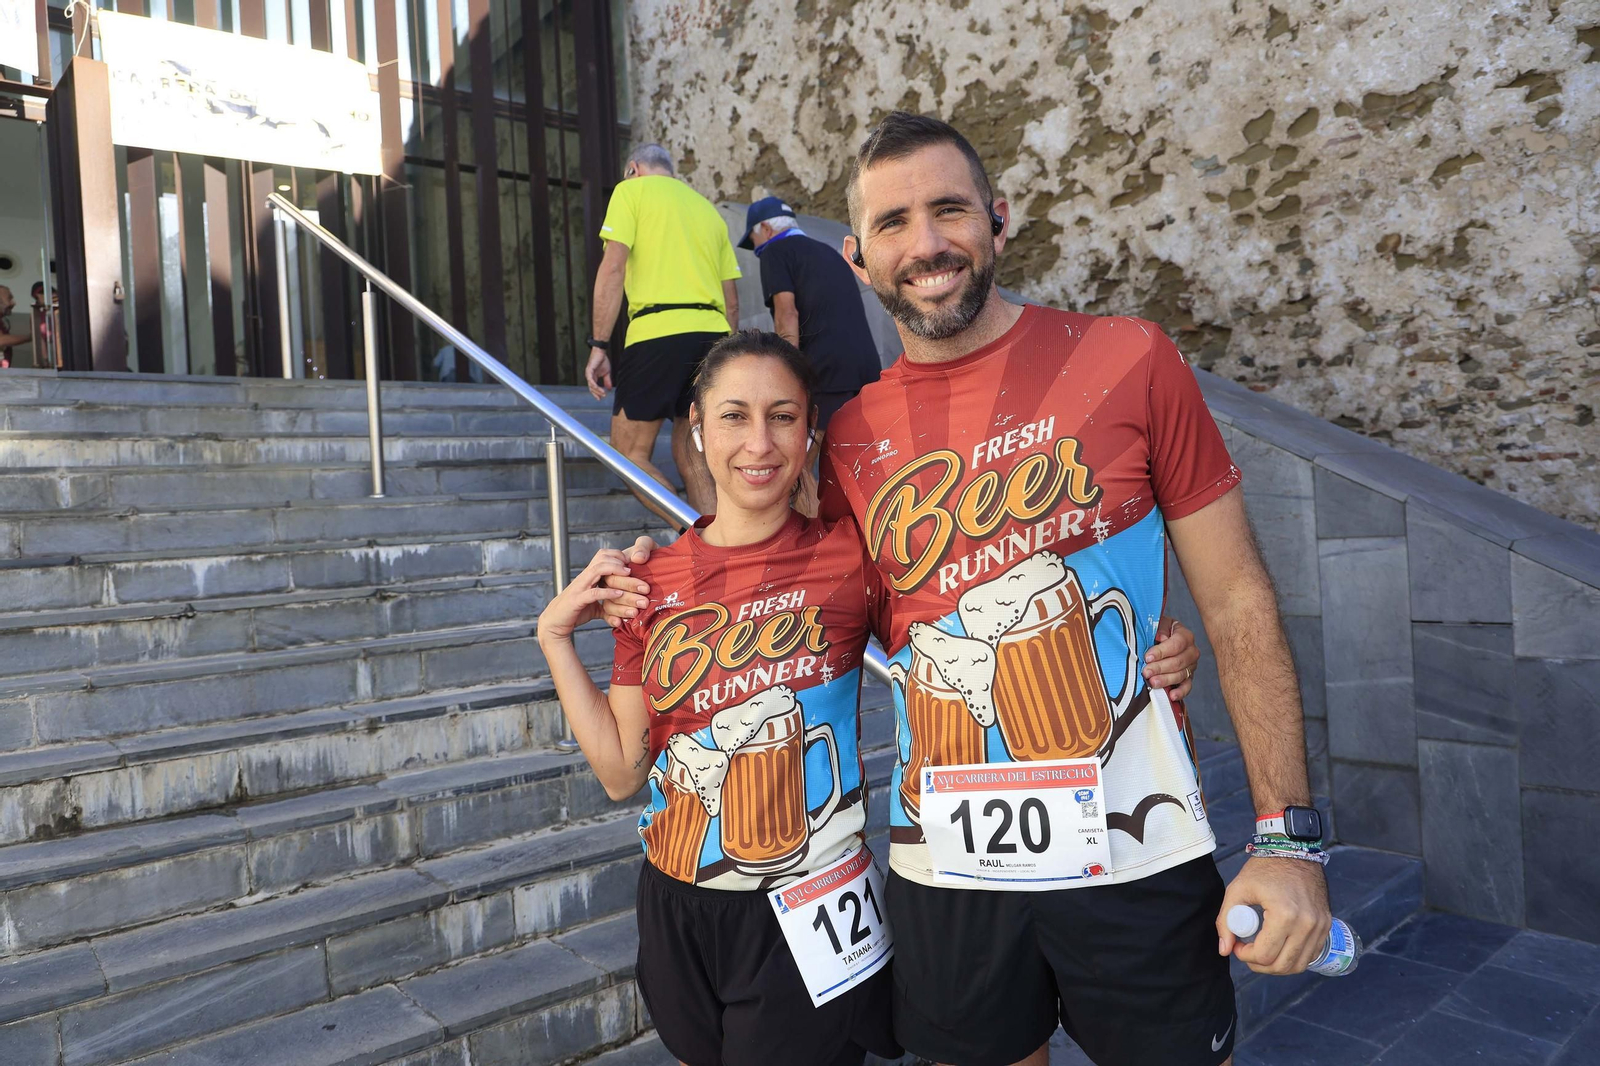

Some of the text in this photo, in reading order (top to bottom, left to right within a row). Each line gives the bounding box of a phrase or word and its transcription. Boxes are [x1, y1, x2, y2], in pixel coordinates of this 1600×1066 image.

[971, 415, 1055, 470] FRESH
[865, 436, 1104, 595] Beer
[938, 509, 1085, 595] RUNNER
[736, 589, 806, 623] FRESH
[641, 601, 832, 714] Beer
[692, 653, 817, 714] RUNNER
[936, 766, 1096, 788] XVI CARRERA DEL ESTRECHO
[950, 797, 1051, 854] 120
[1086, 837, 1099, 845] XL
[803, 868, 847, 895] CARRERA
[845, 859, 860, 875] DEL
[979, 859, 1005, 868] RAUL
[812, 876, 883, 955] 121
[842, 943, 873, 965] TATIANA
